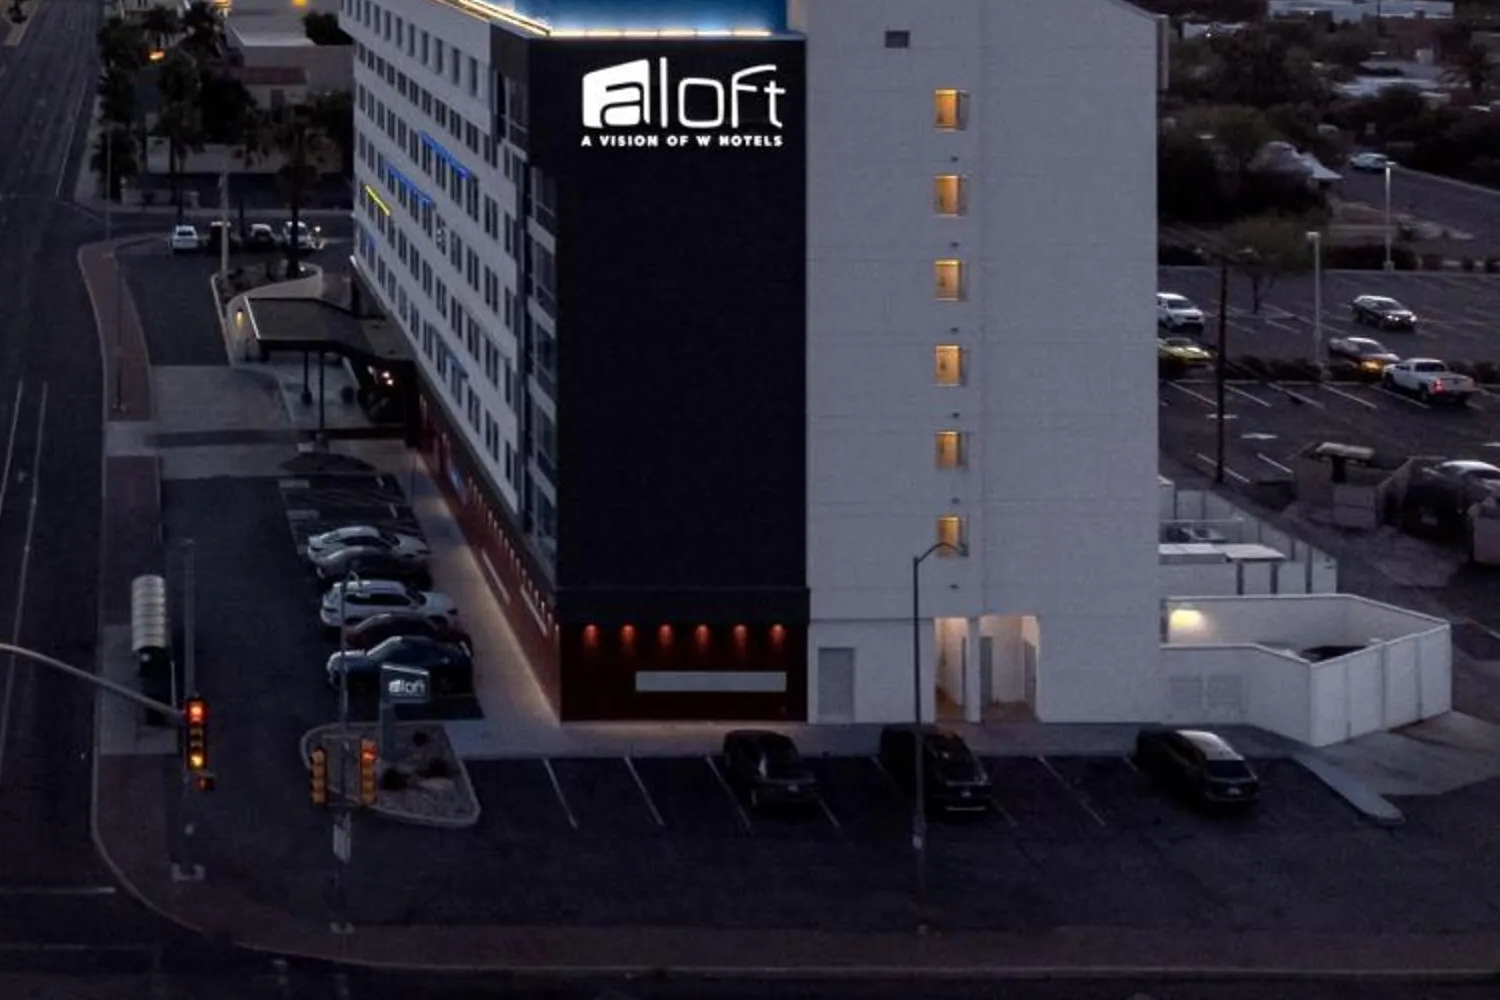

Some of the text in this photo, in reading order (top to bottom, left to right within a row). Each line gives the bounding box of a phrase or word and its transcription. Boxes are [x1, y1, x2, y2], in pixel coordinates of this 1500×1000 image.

[582, 56, 786, 129] aloft
[581, 135, 783, 147] A VISION OF W HOTELS
